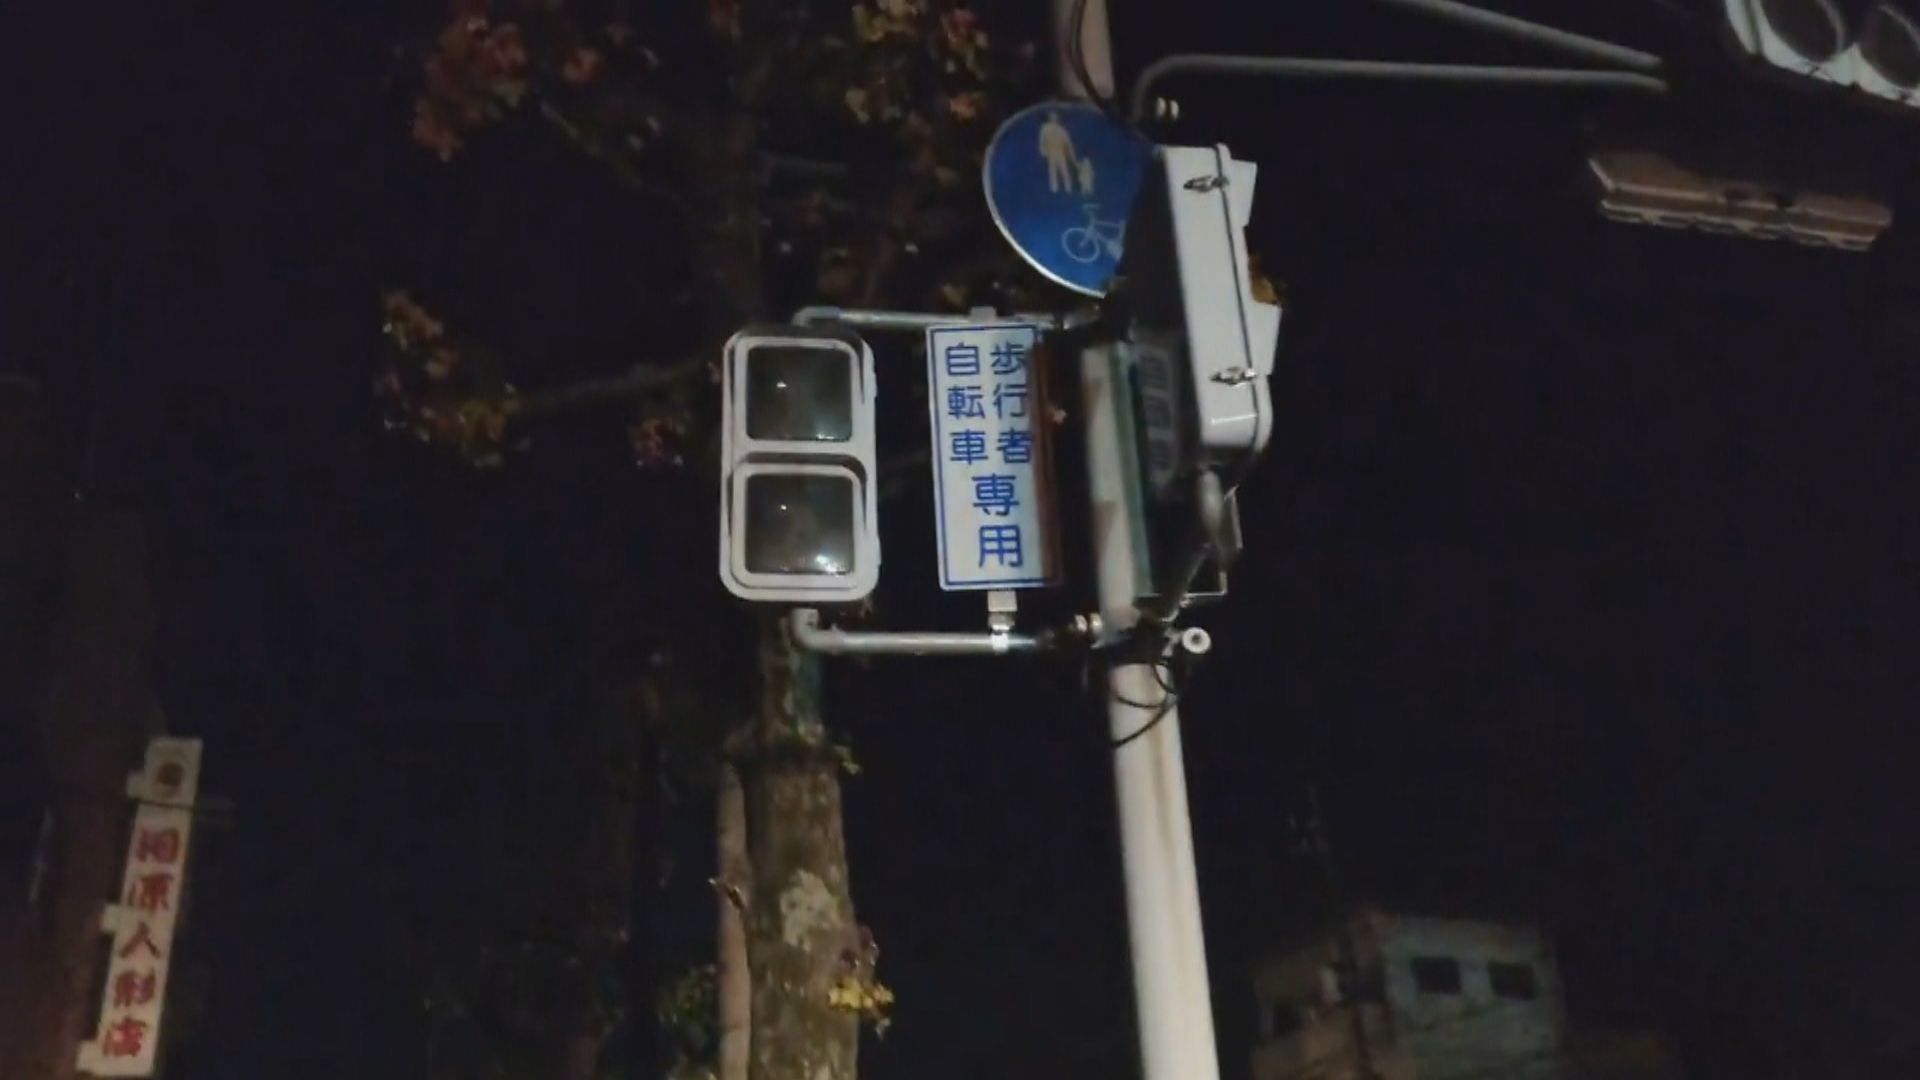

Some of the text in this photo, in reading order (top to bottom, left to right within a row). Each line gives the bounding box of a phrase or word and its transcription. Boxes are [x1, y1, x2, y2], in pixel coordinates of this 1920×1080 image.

[946, 343, 988, 465] 自転車
[990, 341, 1034, 464] 歩行者
[972, 473, 1023, 568] 専用
